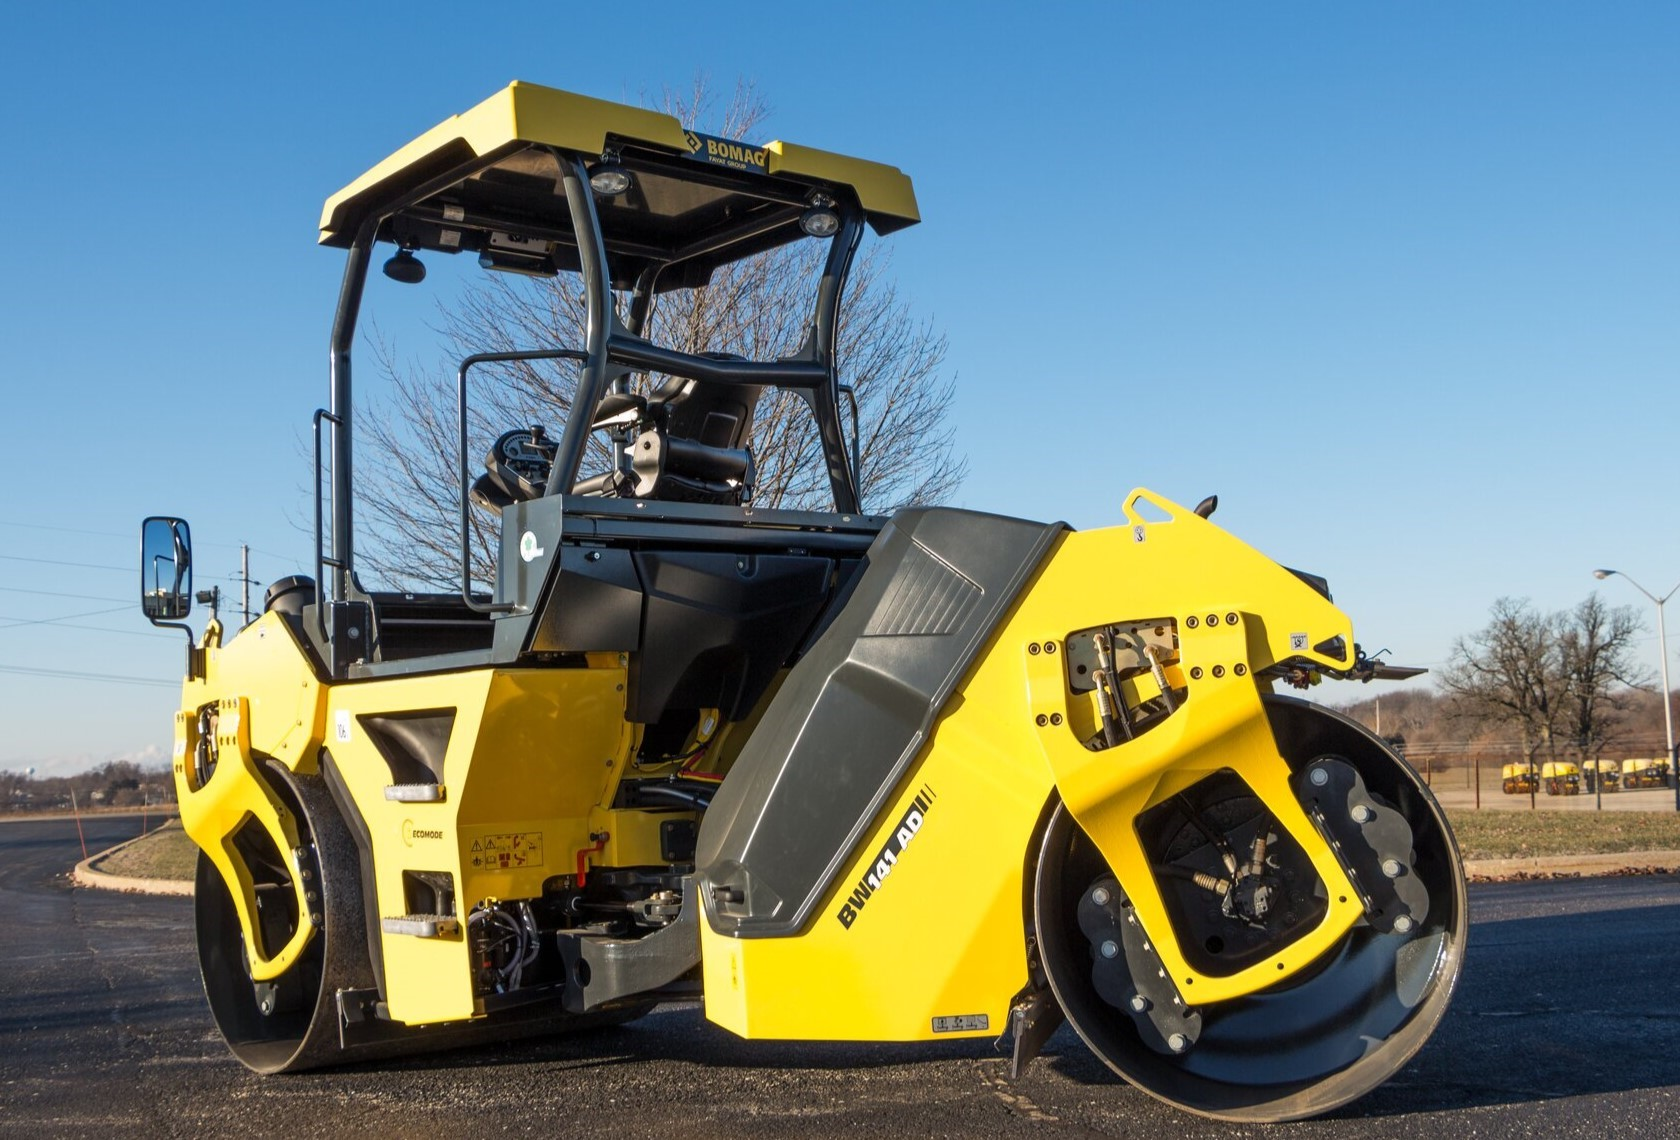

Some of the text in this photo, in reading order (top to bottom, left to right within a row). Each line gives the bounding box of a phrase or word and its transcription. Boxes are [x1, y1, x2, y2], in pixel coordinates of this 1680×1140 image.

[707, 139, 765, 167] BOMAG
[727, 160, 746, 169] GROUP
[412, 830, 443, 839] ECOMODE
